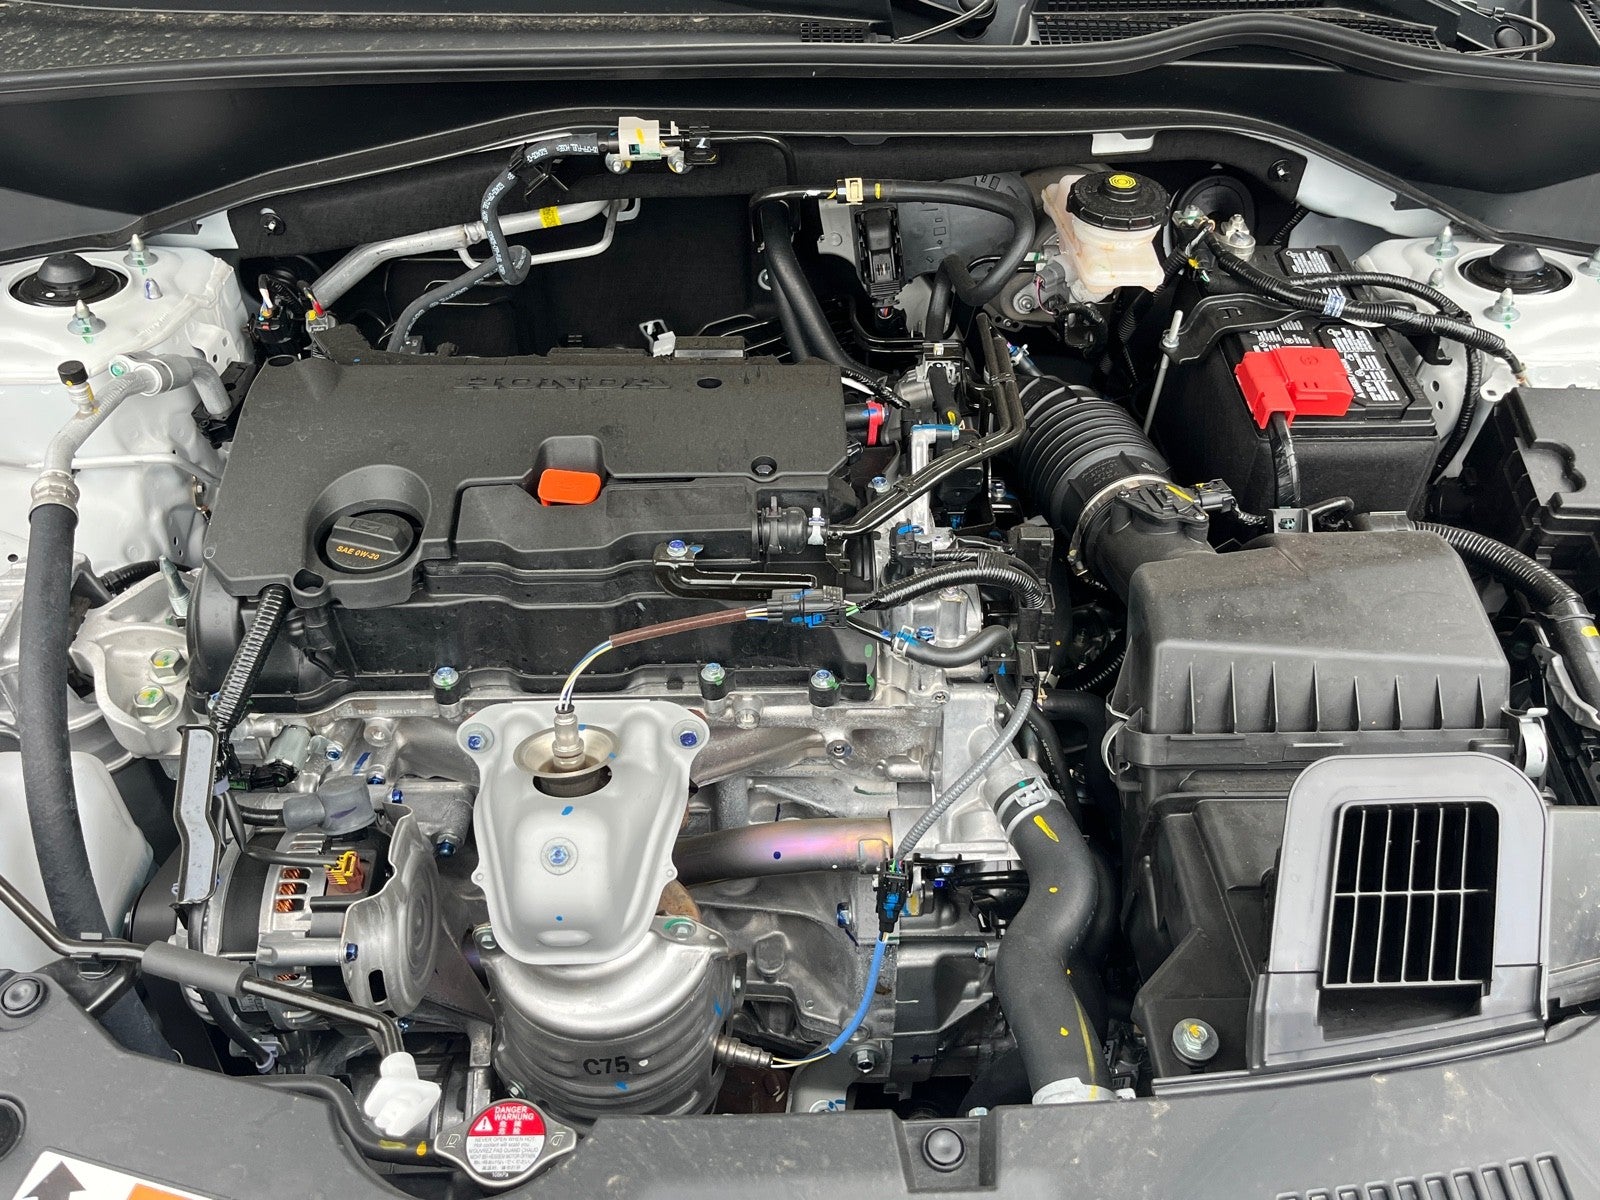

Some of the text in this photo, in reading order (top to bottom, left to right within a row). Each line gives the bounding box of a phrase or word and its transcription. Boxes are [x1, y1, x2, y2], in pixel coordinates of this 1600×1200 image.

[336, 545, 380, 560] SAE 0W-20
[583, 1055, 630, 1075] C75
[495, 1105, 528, 1113] DANGER
[494, 1112, 534, 1121] WARNUNG
